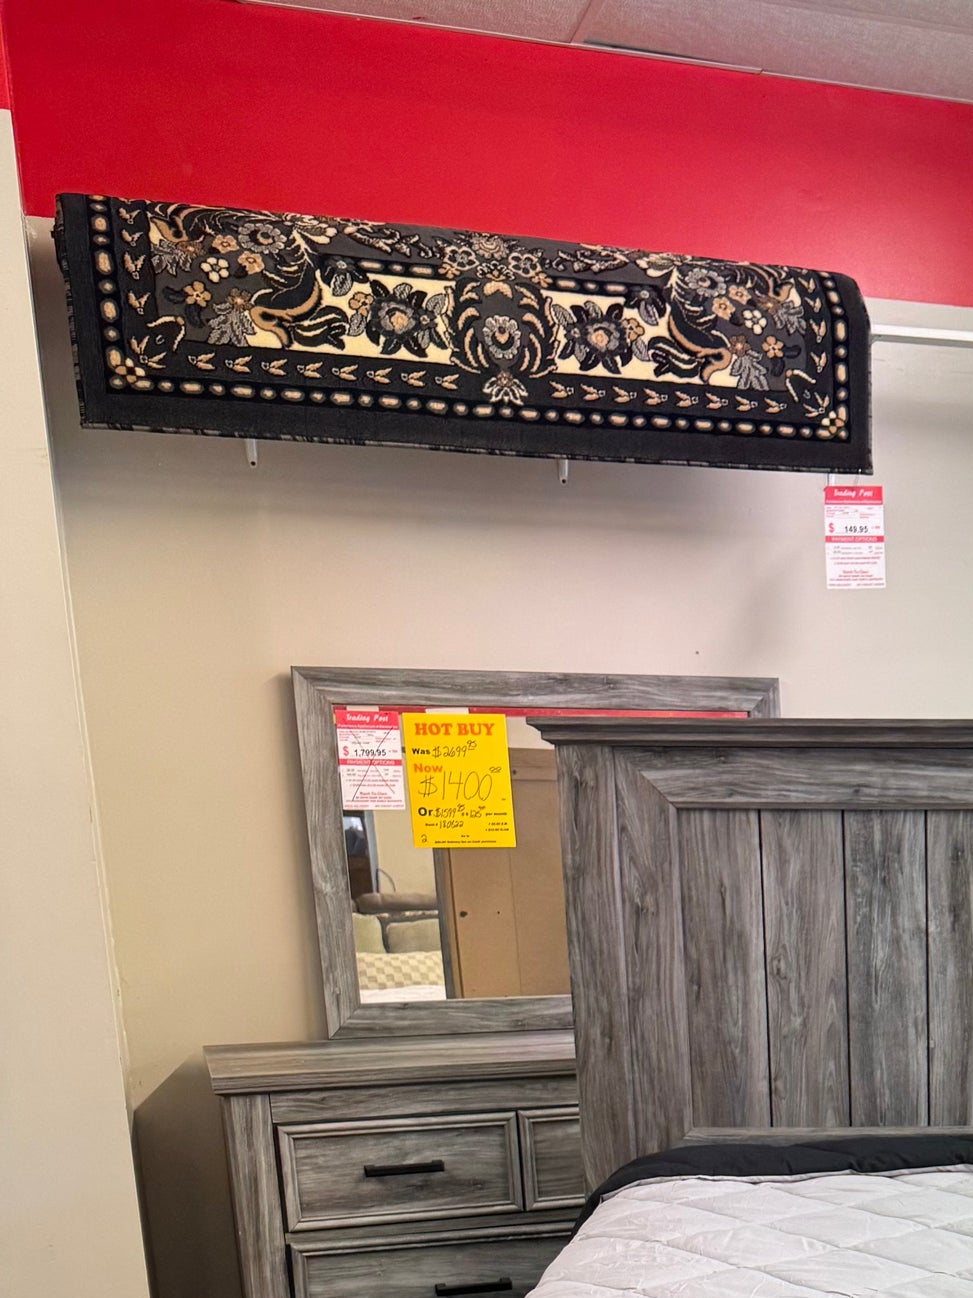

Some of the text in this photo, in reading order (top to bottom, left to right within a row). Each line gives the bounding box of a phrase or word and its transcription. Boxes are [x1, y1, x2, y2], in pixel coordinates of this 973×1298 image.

[828, 522, 869, 534] $ 149.95
[346, 713, 389, 723] Trading Post
[414, 722, 495, 736] HOT BUY
[342, 745, 350, 757] $
[413, 763, 443, 773] Now
[418, 806, 433, 816] Or
